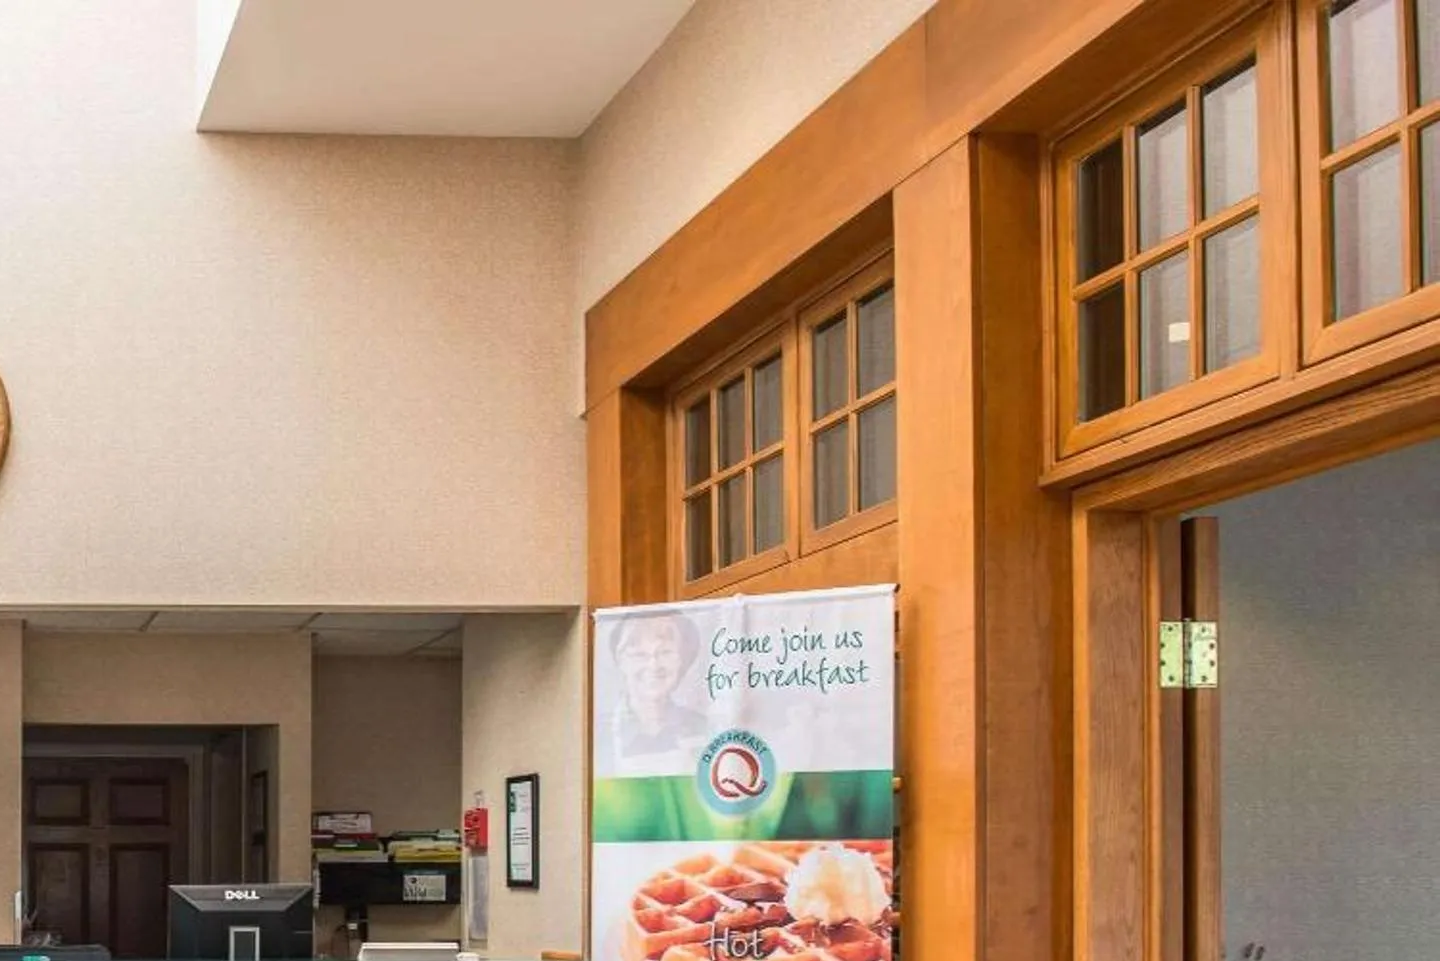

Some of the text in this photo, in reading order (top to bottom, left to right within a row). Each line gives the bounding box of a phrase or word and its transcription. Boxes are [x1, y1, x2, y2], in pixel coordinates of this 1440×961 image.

[712, 624, 864, 665] Come join us
[705, 657, 870, 701] for breakfast
[224, 890, 260, 901] DELL
[704, 921, 764, 961] Hot
